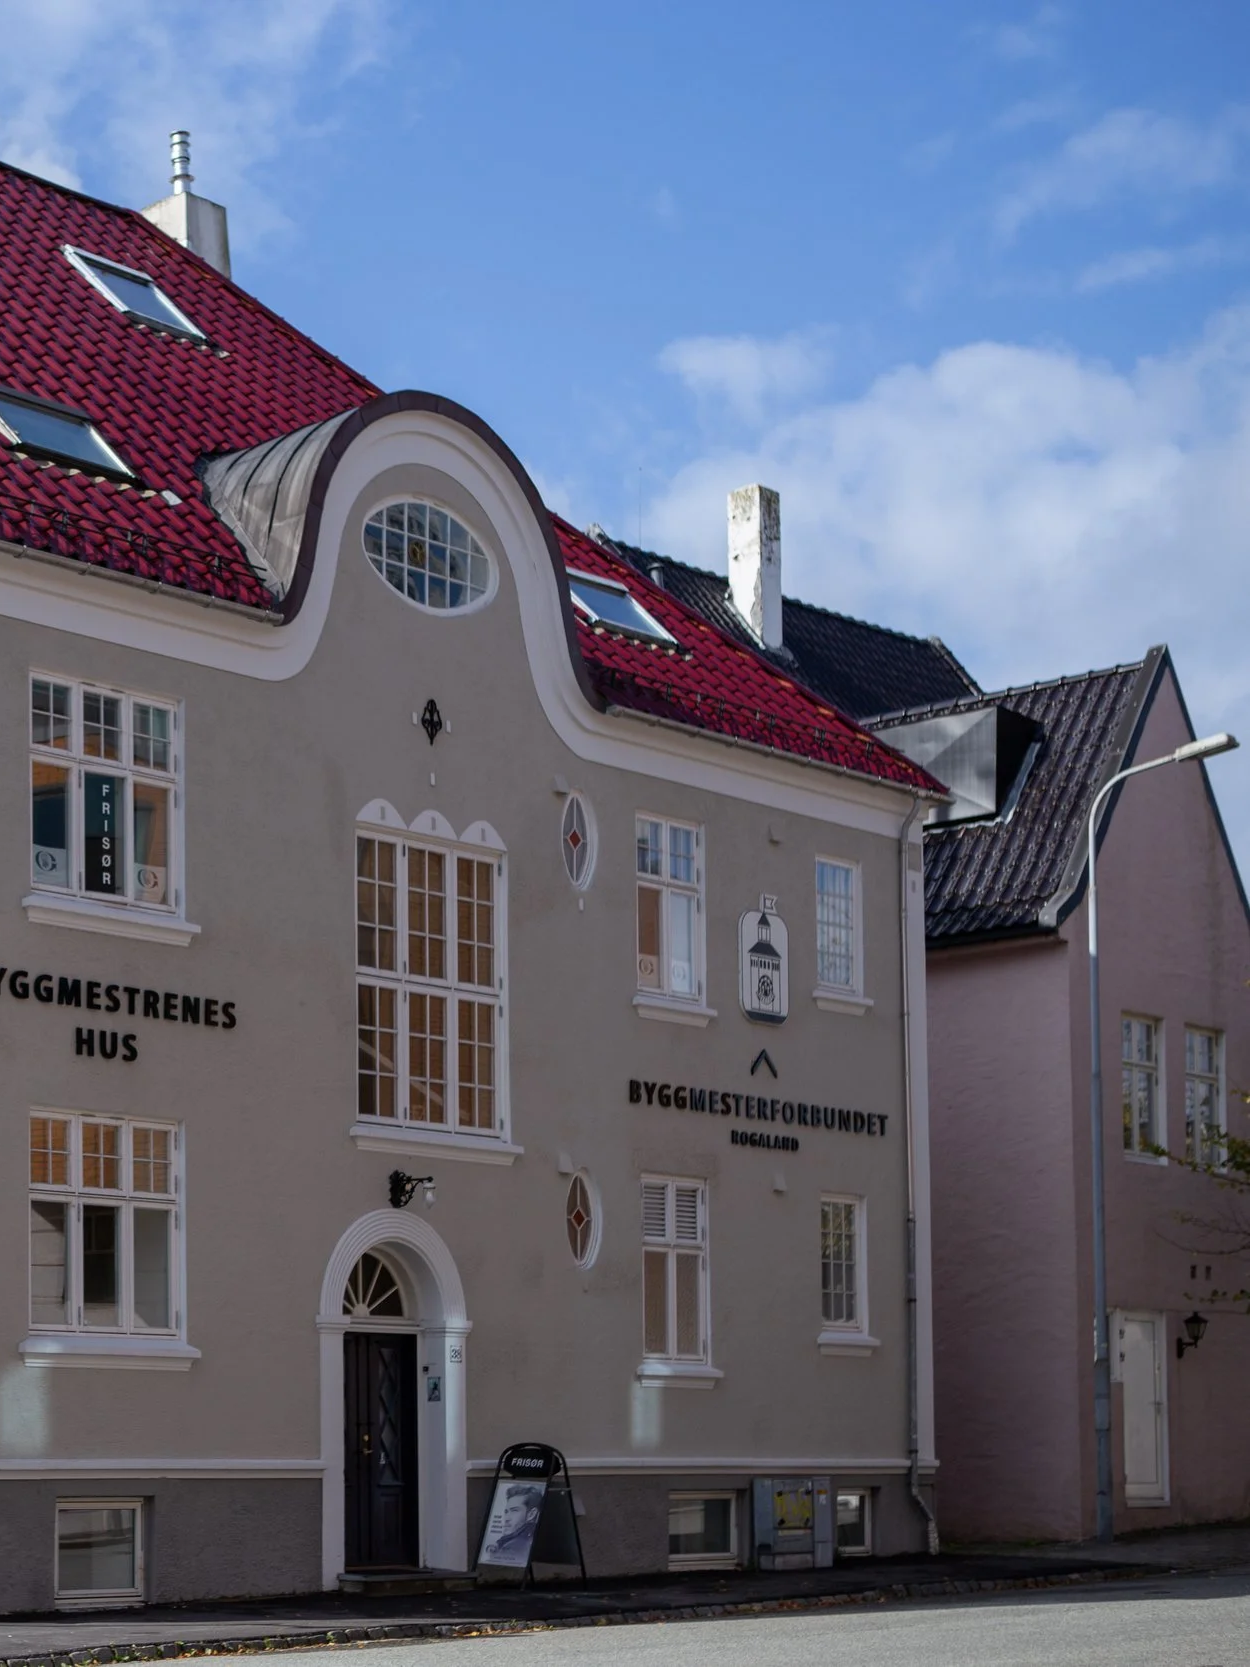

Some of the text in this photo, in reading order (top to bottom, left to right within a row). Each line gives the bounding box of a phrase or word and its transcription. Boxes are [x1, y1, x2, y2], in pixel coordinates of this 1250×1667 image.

[101, 784, 111, 885] FRISØR
[75, 1027, 139, 1062] HUS
[628, 1079, 889, 1137] BYGGMESTERFORBUNDET
[731, 1129, 800, 1152] ROGALAND
[511, 1457, 544, 1469] FRISØR
